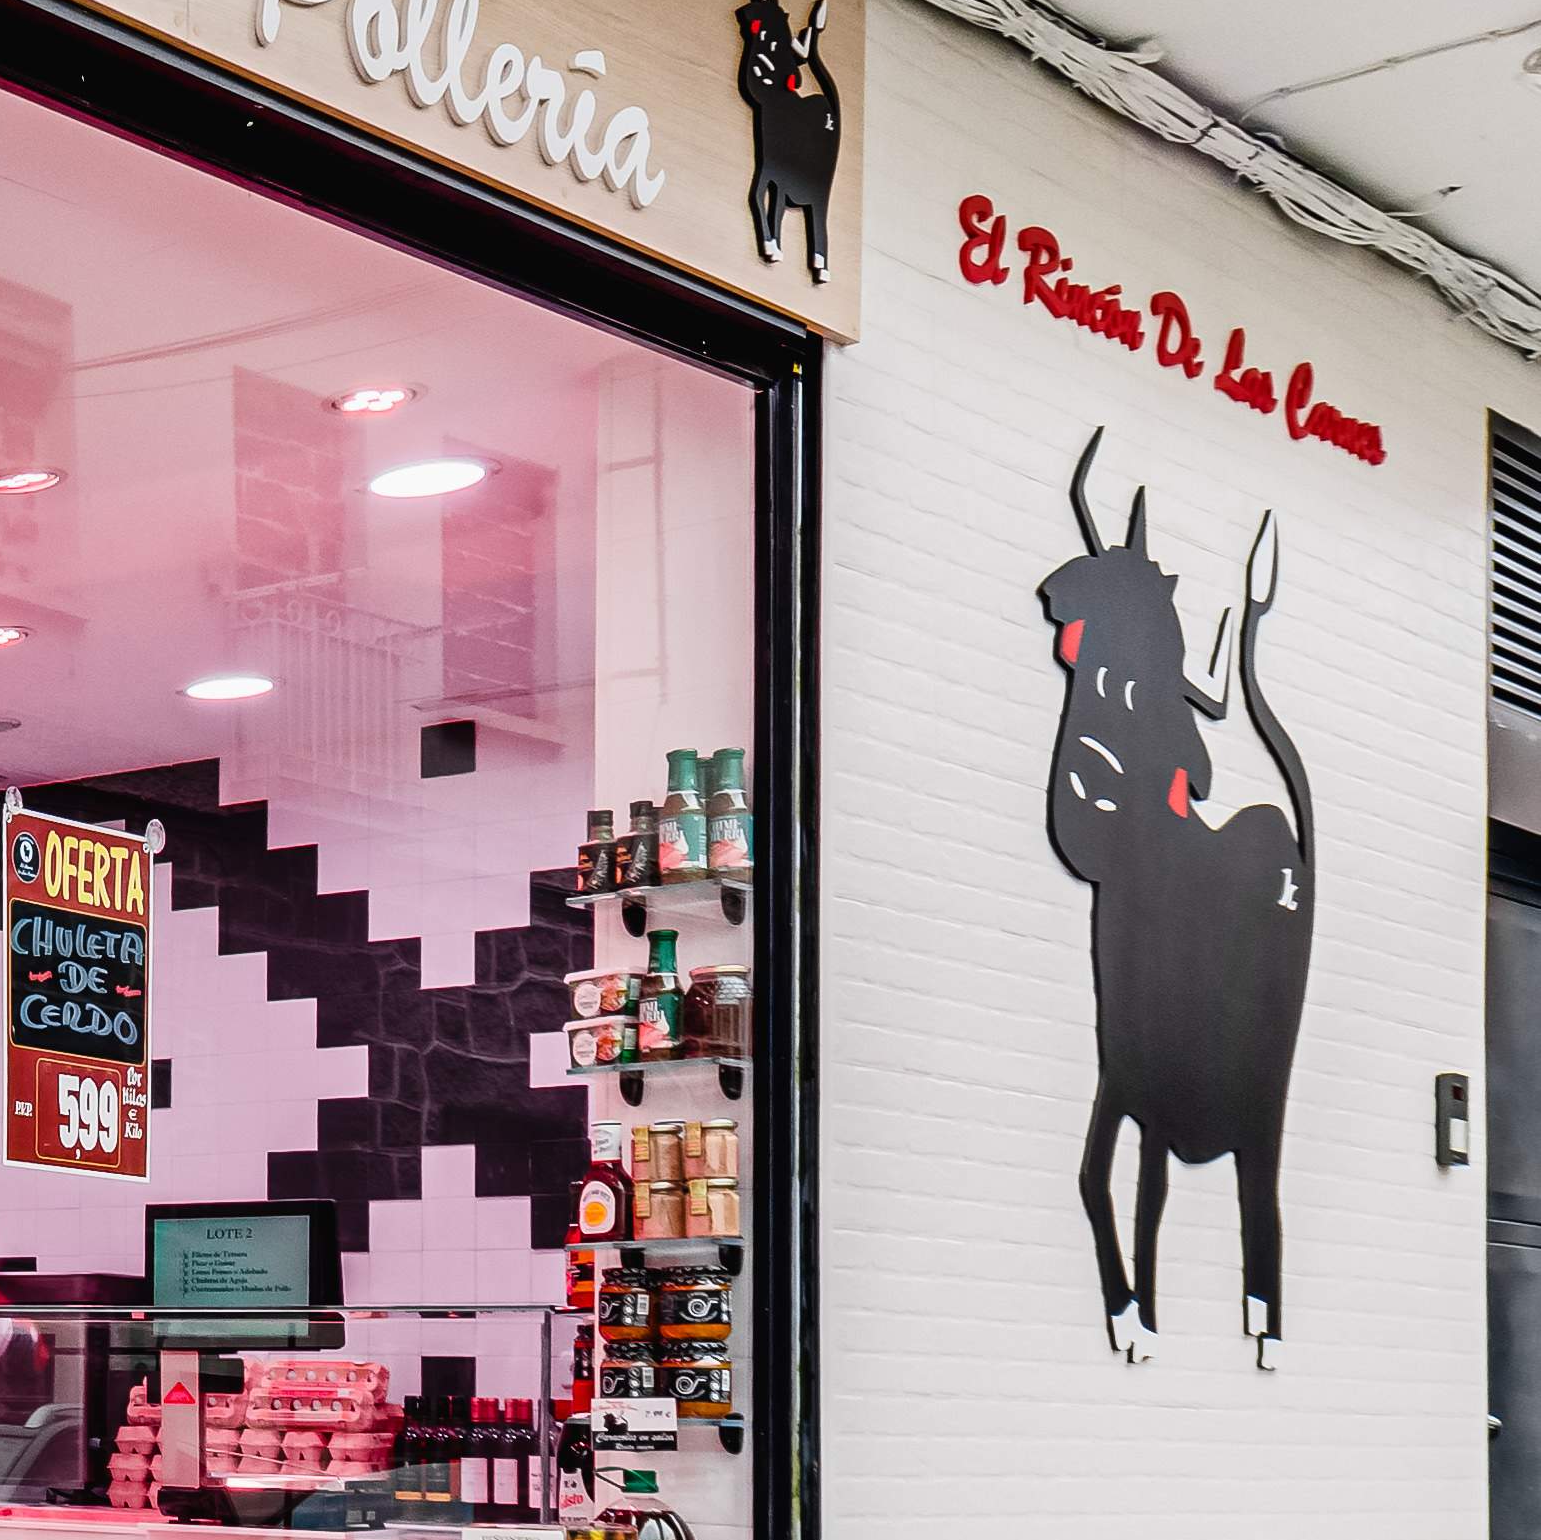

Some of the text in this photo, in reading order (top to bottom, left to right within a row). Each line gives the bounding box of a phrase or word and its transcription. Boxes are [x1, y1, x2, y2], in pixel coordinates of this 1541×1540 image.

[958, 194, 1387, 466] El Rincón De Las Carnes
[44, 830, 144, 916] OFERTA
[11, 916, 144, 966] CHULETA
[57, 960, 107, 995] DE
[19, 994, 138, 1046] CERDO
[127, 1066, 142, 1087] Por
[58, 1073, 118, 1160] 5,99
[124, 1122, 143, 1140] Kilo
[128, 1109, 137, 1121] €
[206, 1228, 253, 1240] LOTE 2
